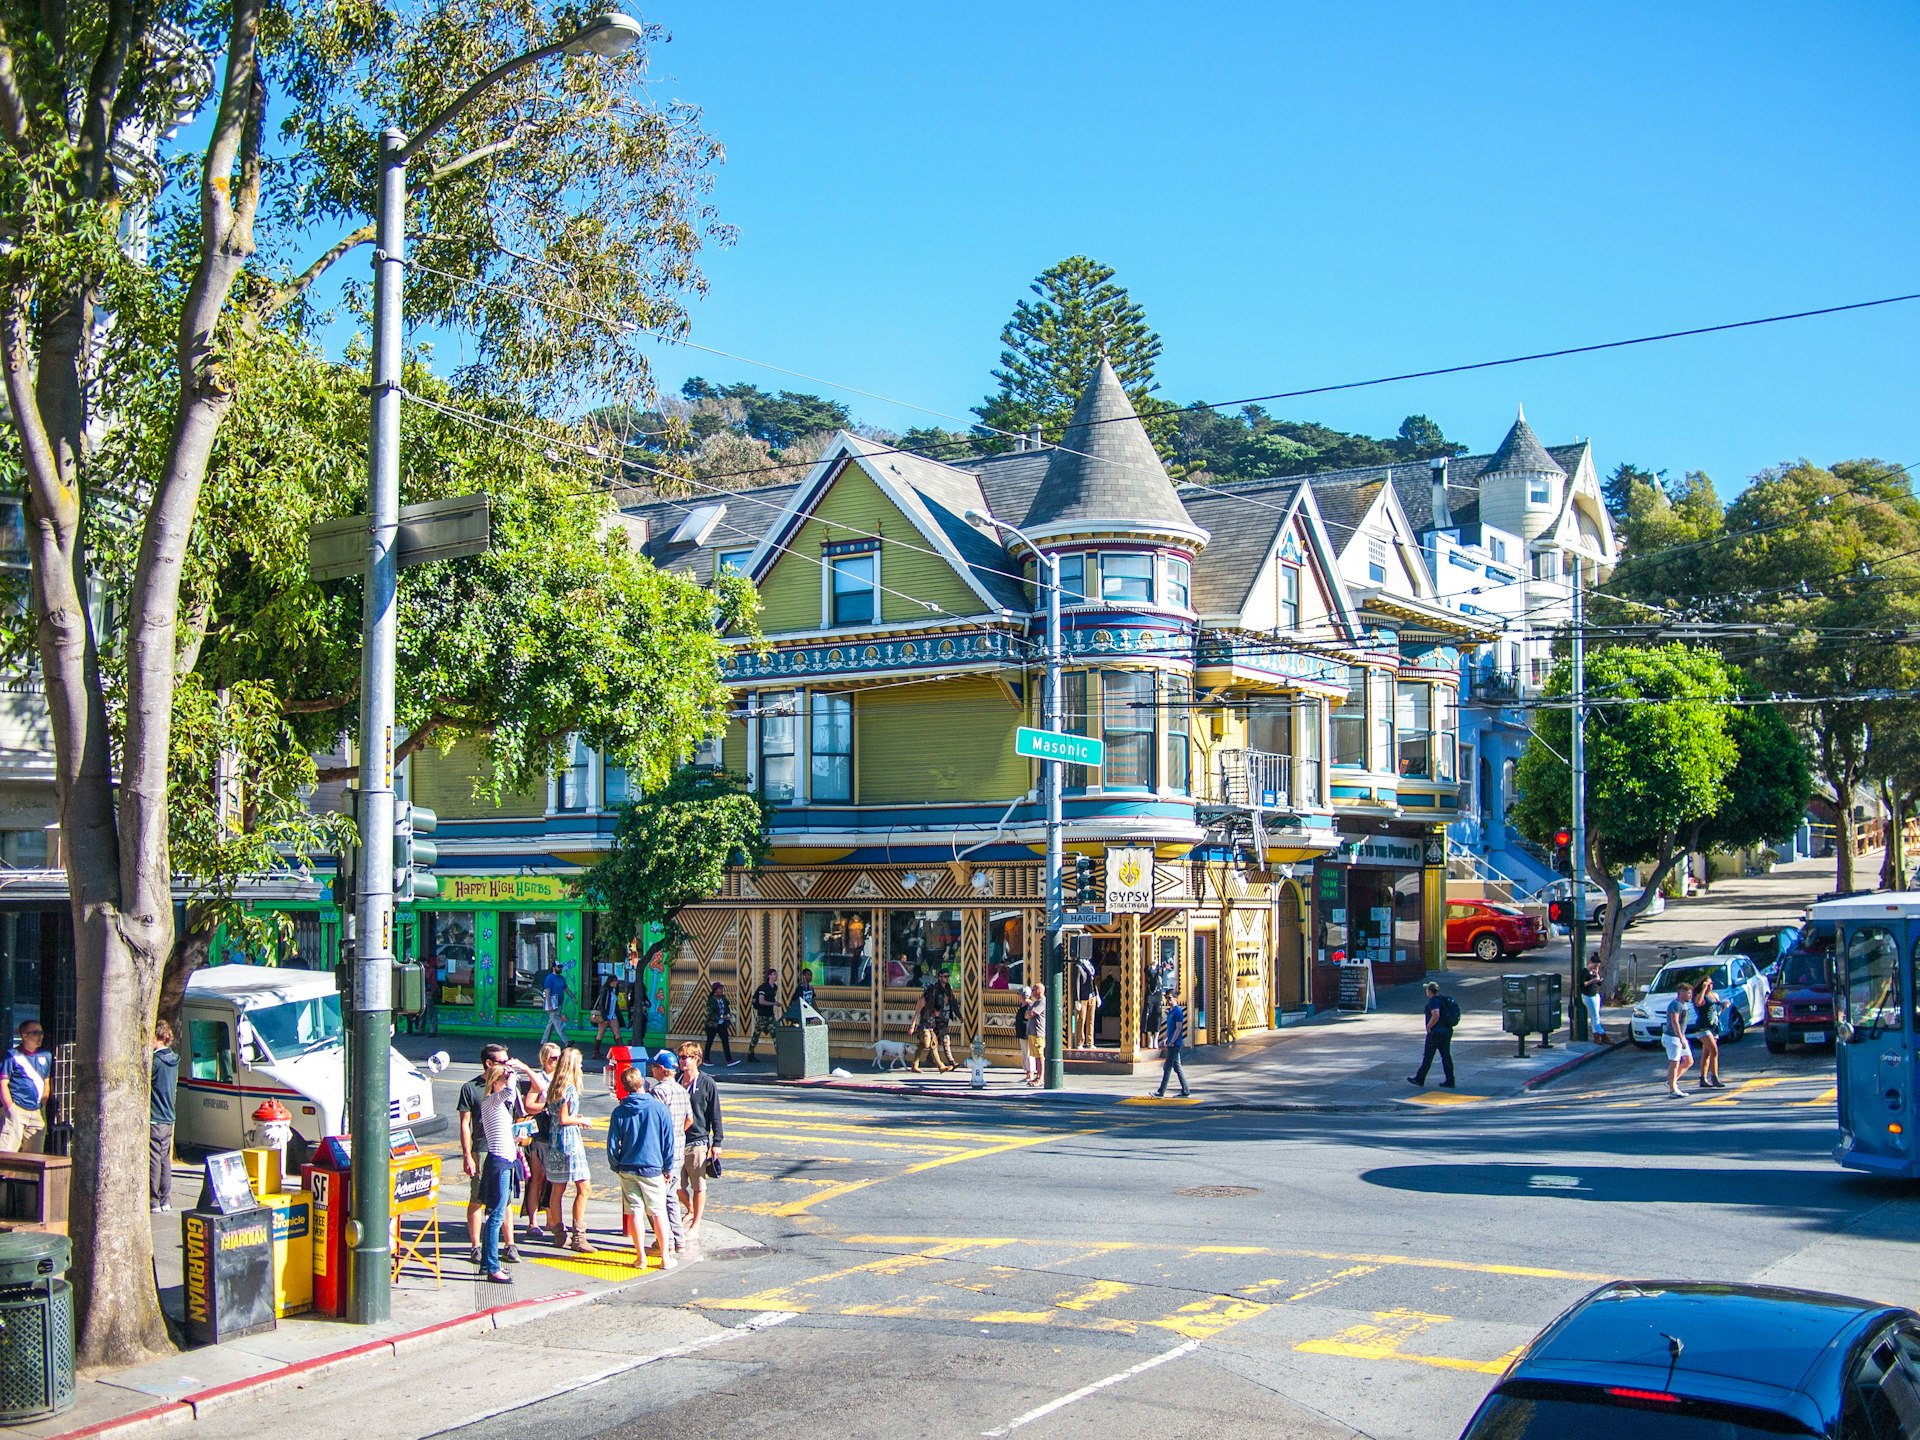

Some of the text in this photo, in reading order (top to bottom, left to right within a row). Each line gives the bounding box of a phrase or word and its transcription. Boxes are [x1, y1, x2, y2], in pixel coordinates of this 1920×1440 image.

[1032, 736, 1088, 758] Masonic
[516, 881, 551, 896] HERBS
[1109, 891, 1149, 902] GYPSY
[313, 1174, 327, 1202] SF
[394, 1178, 432, 1195] Advertiser
[220, 1227, 268, 1250] GUARDIAN
[187, 1217, 207, 1323] GUARDIAN
